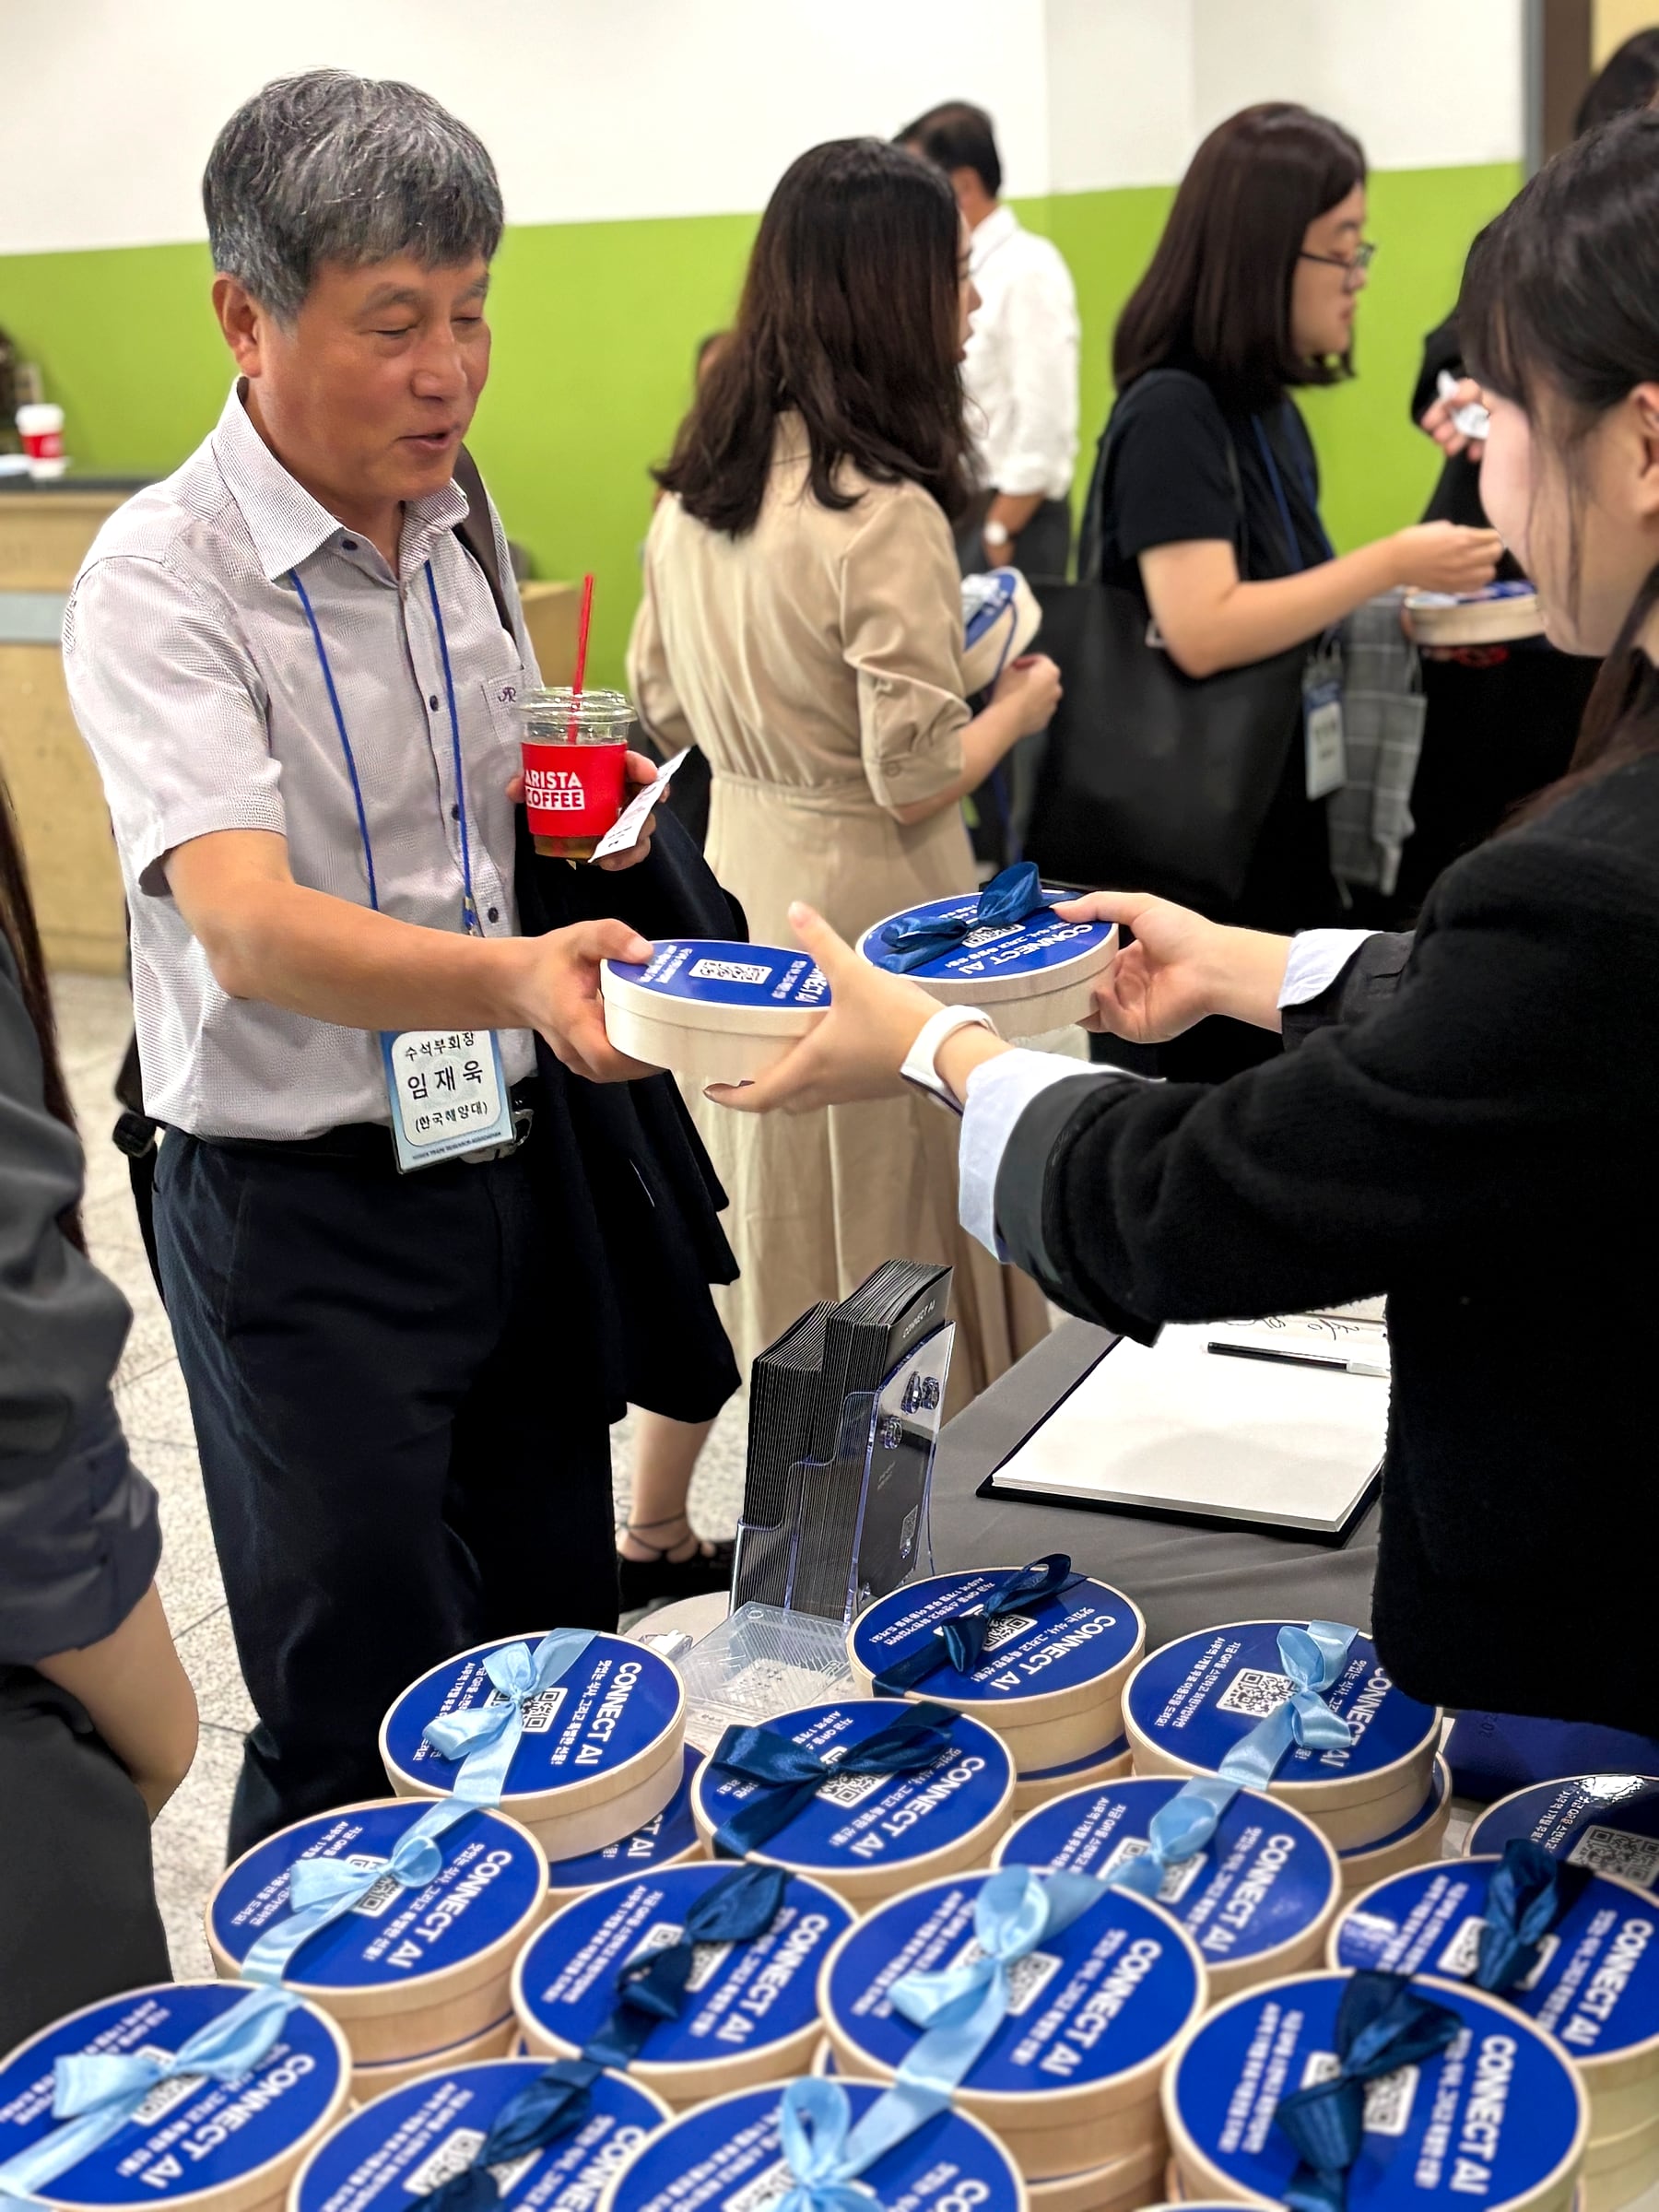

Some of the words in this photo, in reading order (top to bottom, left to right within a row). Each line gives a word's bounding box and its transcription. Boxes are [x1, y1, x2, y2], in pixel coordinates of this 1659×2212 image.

[990, 924, 1092, 964] CONNECT
[959, 961, 984, 974] AI
[405, 1031, 475, 1062] 수석부회장
[415, 1100, 488, 1133] (한국해양대)
[1019, 1616, 1116, 1675] CONNECT
[1206, 1637, 1225, 1655] AI무역
[1225, 1642, 1241, 1653] 지금
[457, 1663, 476, 1681] AI무역
[591, 1660, 612, 1680] 맛있는
[1194, 1655, 1213, 1670] 1개월
[1214, 1653, 1232, 1669] QR을
[1345, 1660, 1367, 1679] 맛있는
[466, 1677, 483, 1693] QR을
[990, 1671, 1020, 1690] AI
[1186, 1670, 1202, 1682] 무료
[1198, 1669, 1220, 1692] 스캔하고
[447, 1682, 465, 1698] 1개월
[458, 1694, 473, 1709] 스캔
[587, 1662, 641, 1742] CONNECT
[441, 1699, 455, 1714] 무료
[572, 1699, 592, 1722] 그리고
[1155, 1705, 1176, 1726] 드려요!
[559, 1722, 582, 1746] 특별한
[575, 1744, 603, 1764] AI
[1295, 1748, 1311, 1759] 물!
[1321, 1751, 1349, 1767] AI
[881, 1758, 985, 1837] CONNECT
[627, 1837, 654, 1857] AI
[851, 1832, 884, 1857] AI
[1219, 1835, 1295, 1929] CONNECT
[415, 1851, 512, 1942] CONNECT
[1200, 1925, 1236, 1951] AI
[387, 1940, 422, 1968] AI
[741, 1914, 829, 2016] CONNECT
[1577, 1920, 1653, 2019] CONNECT
[1061, 1940, 1161, 2047] CONNECT
[717, 2013, 753, 2042] AI
[1560, 2017, 1604, 2044] AI
[1041, 2043, 1080, 2075] AI
[182, 2054, 314, 2159] CONNECT
[1460, 2036, 1515, 2160] CONNECT
[141, 2155, 182, 2187] AI
[546, 2124, 647, 2212] CONNE
[1452, 2159, 1489, 2193] AI
